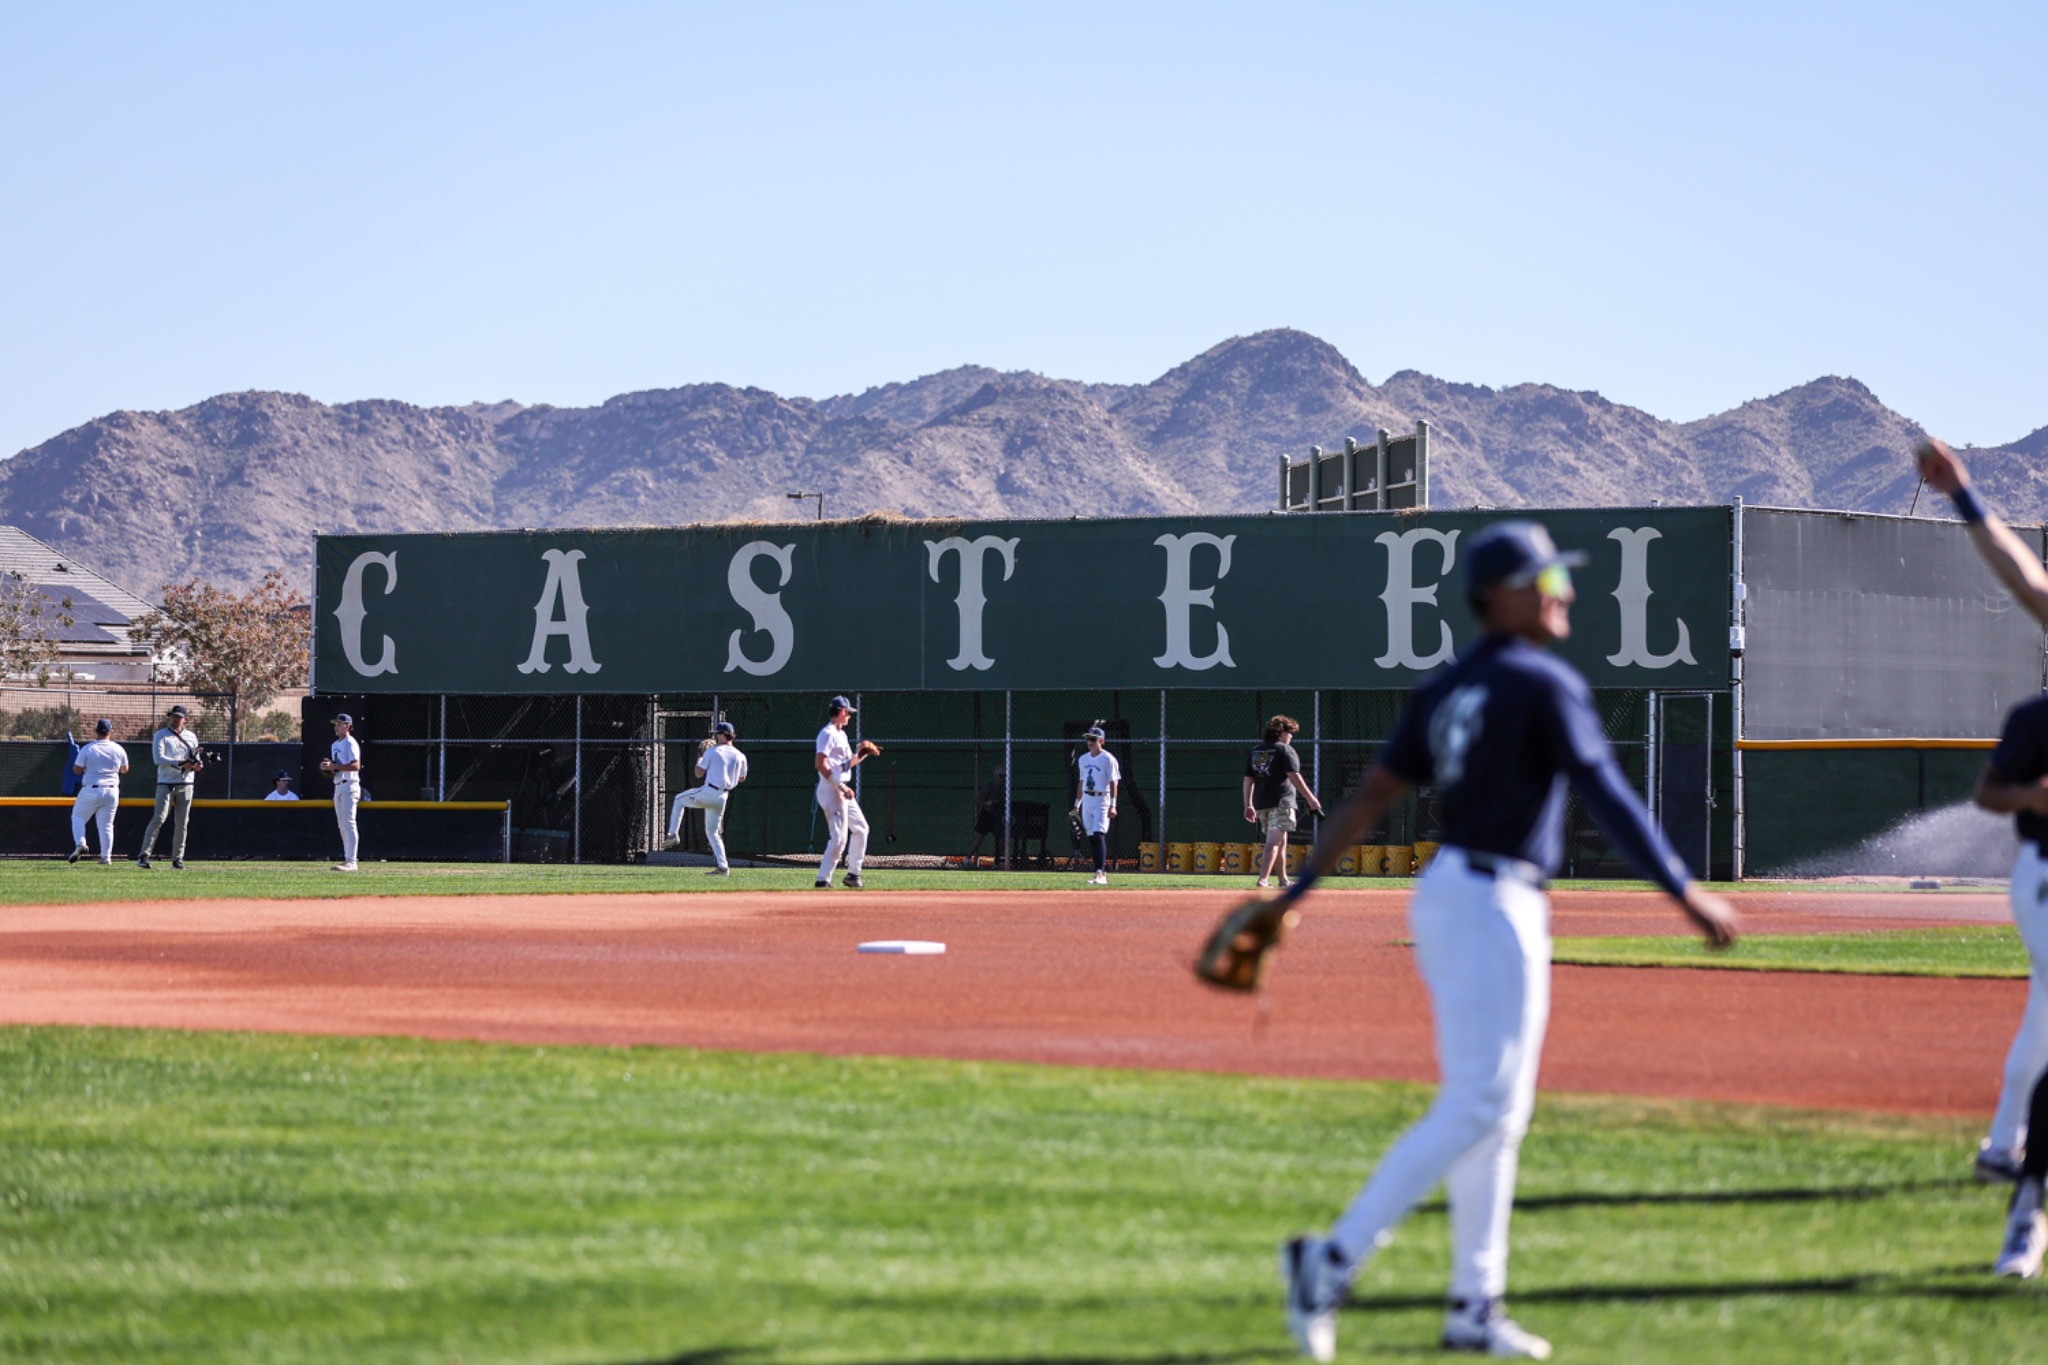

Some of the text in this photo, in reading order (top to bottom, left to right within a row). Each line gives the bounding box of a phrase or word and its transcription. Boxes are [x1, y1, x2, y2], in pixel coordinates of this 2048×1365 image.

[333, 527, 1698, 677] CASTEEL
[1142, 853, 1154, 868] C
[1169, 853, 1182, 868] C
[1226, 852, 1240, 868] C
[1338, 857, 1354, 873] C
